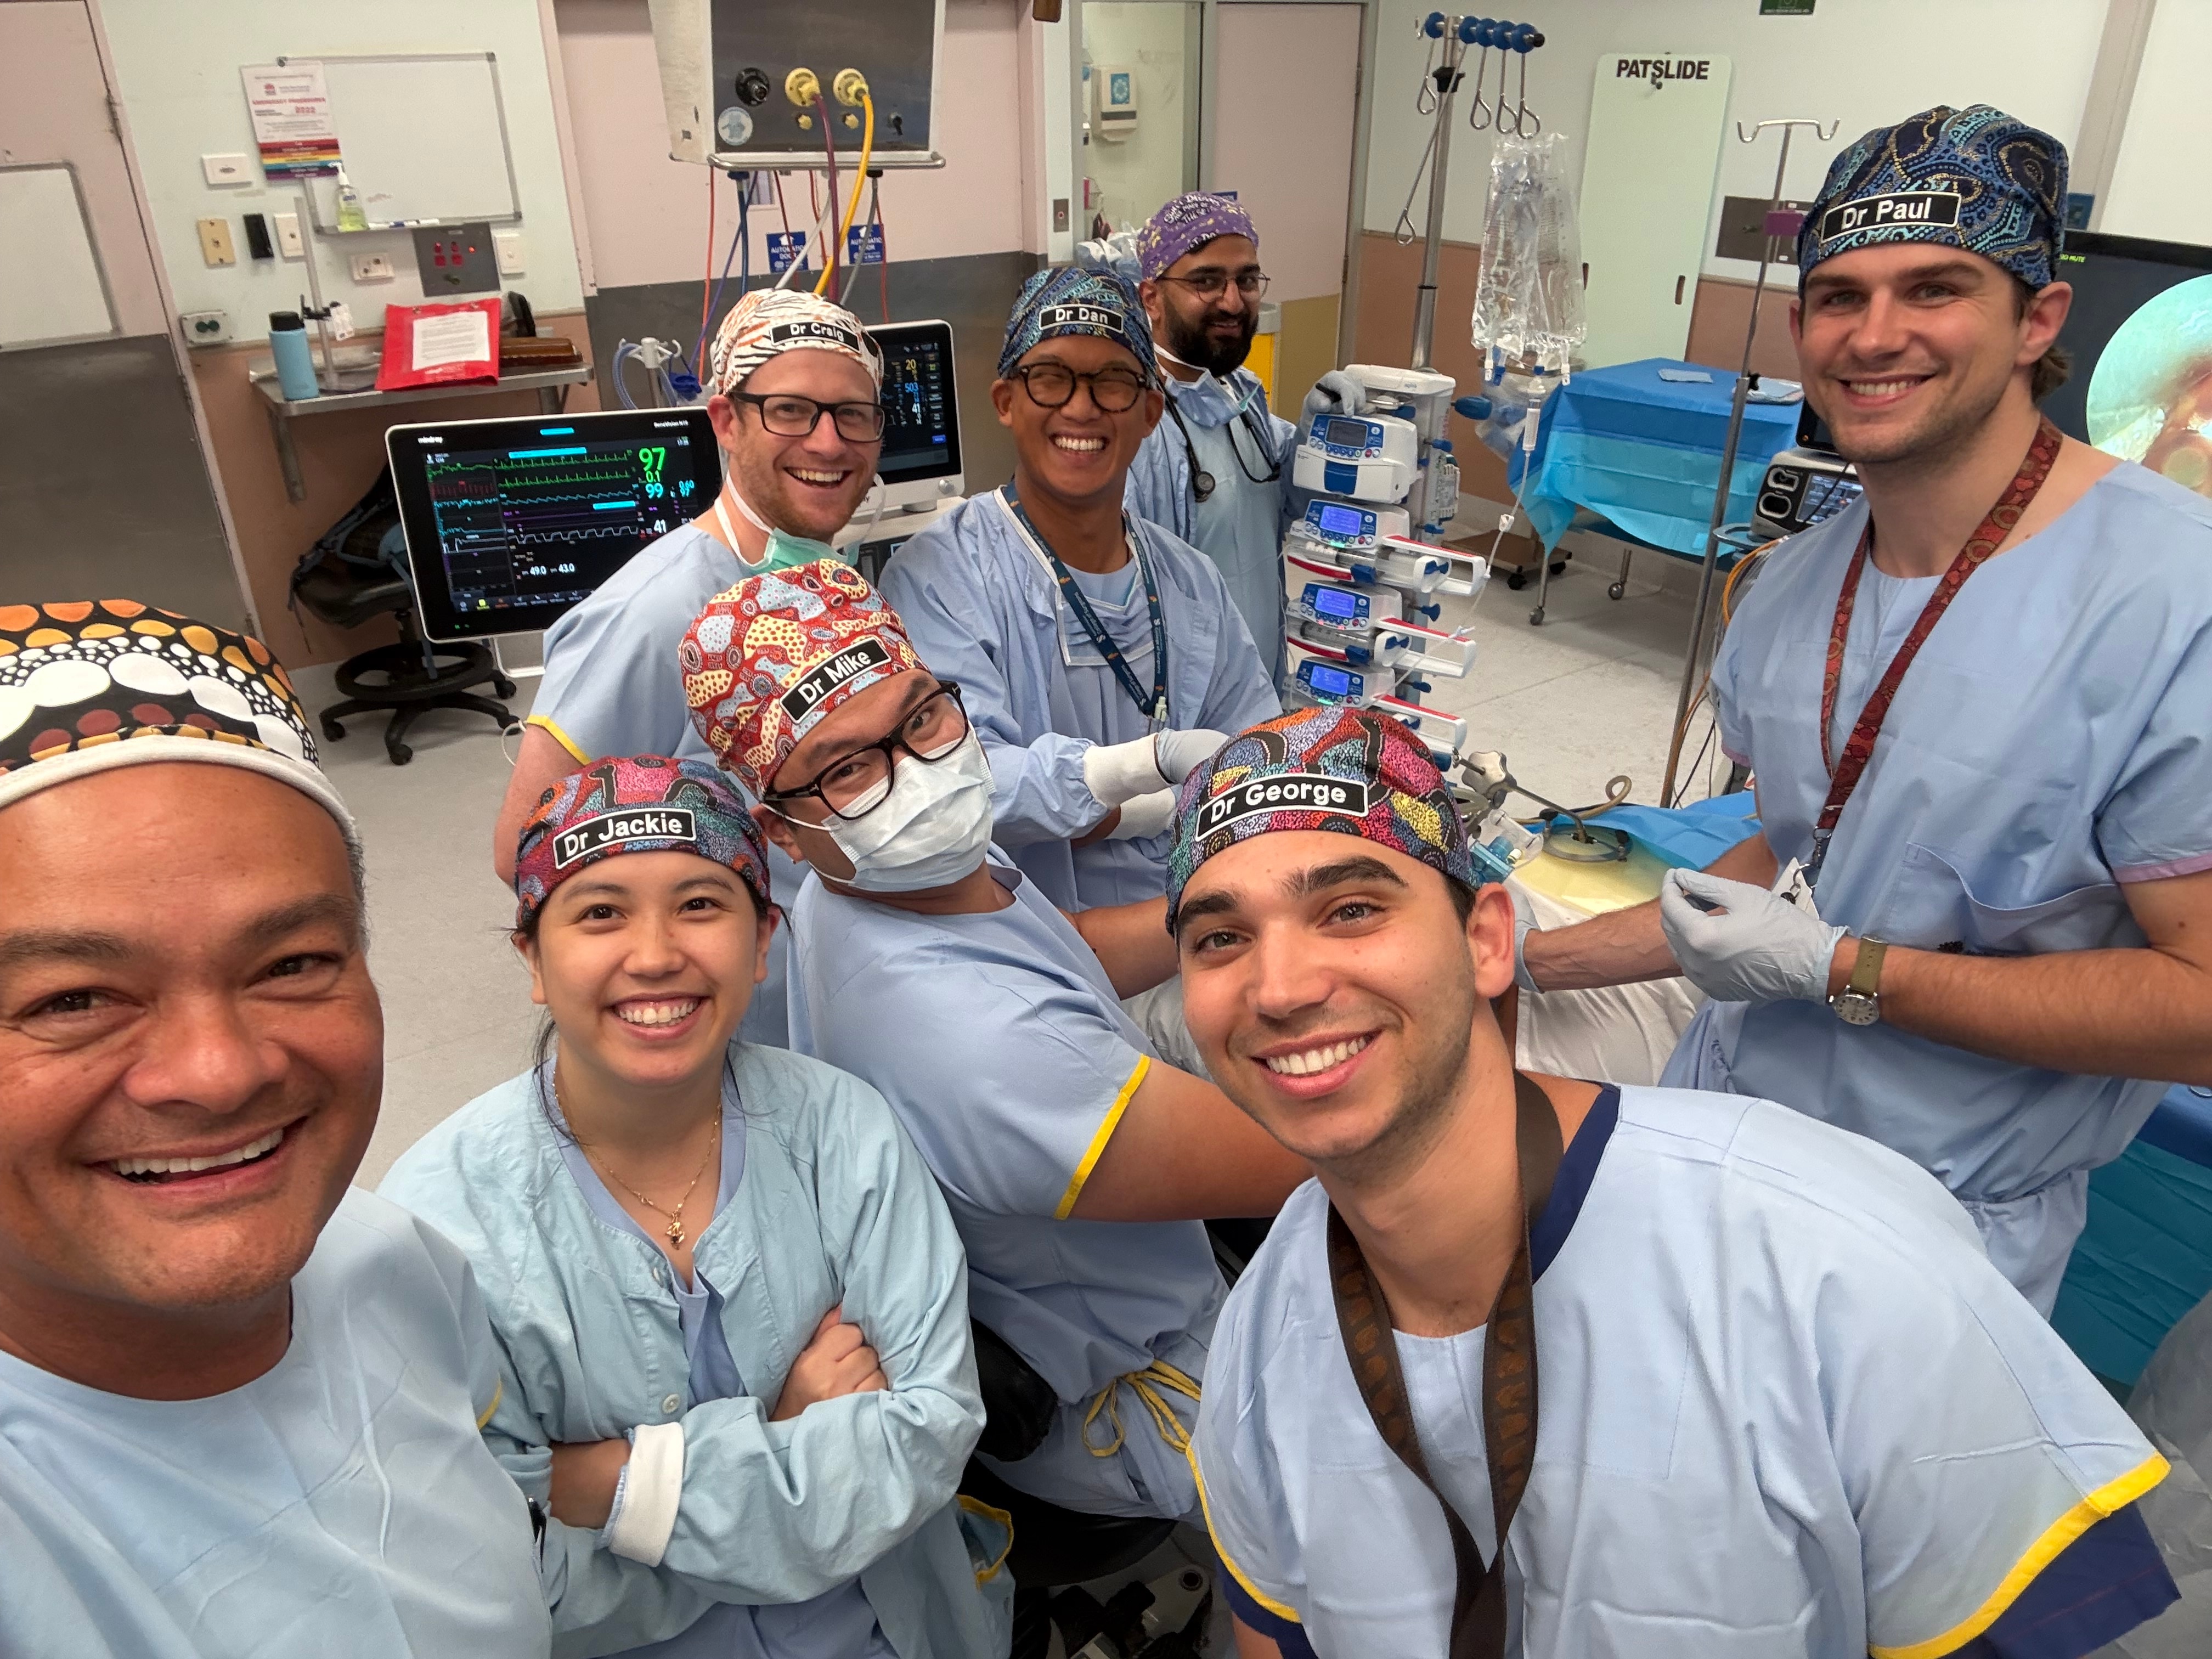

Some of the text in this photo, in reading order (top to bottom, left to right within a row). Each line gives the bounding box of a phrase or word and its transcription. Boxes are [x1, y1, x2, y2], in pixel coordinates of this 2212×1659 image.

[1616, 59, 1710, 80] PATSLIDE
[1841, 197, 1932, 230] Dr Paul
[1055, 307, 1108, 324] Dr Dan
[790, 323, 844, 342] Dr Craig
[639, 447, 665, 471] 97
[645, 482, 663, 499] 99
[653, 519, 667, 533] 41
[798, 651, 871, 704] Dr Mike
[1211, 783, 1346, 823] Dr George
[564, 814, 682, 858] Dr Jackie
